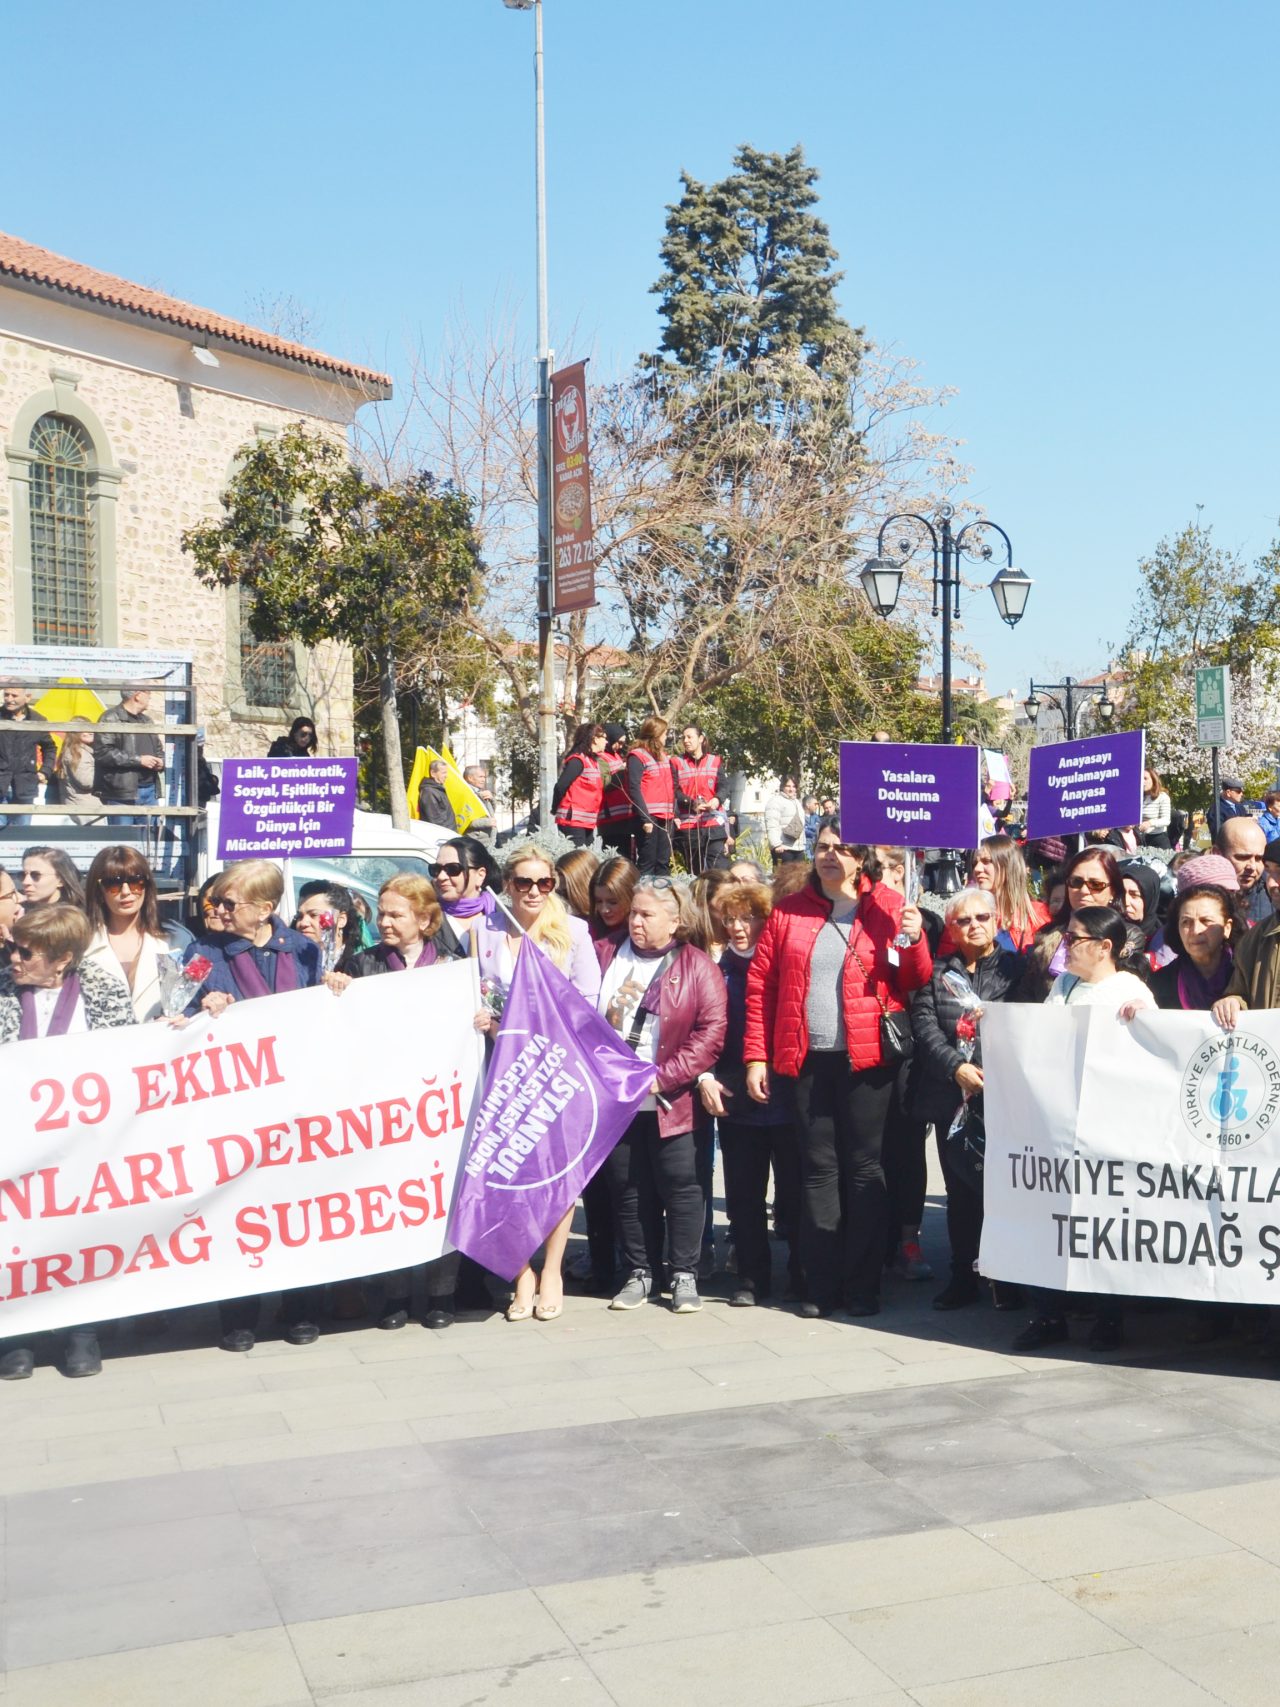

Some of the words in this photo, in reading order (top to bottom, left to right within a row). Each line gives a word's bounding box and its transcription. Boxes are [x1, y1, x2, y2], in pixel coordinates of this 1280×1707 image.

[559, 545, 571, 568] 263
[573, 542, 582, 564] 72
[583, 539, 593, 561] 72
[1058, 752, 1112, 769] Anayasayı
[237, 766, 268, 780] Laik,
[271, 765, 347, 779] Demokratik,
[881, 770, 936, 784] Yasalara
[1048, 768, 1119, 789] Uygulamayan
[233, 783, 279, 799] Sosyal,
[281, 782, 329, 799] Eşitlikçi
[331, 784, 345, 795] ve
[878, 788, 940, 802] Dokunma
[1061, 786, 1106, 802] Anayasa
[243, 800, 315, 817] Özgürlükçü
[317, 801, 335, 813] Bir
[886, 807, 932, 823] Uygula
[1059, 803, 1107, 819] Yapamaz
[256, 820, 297, 835] Dünya
[299, 817, 321, 834] İçin
[225, 837, 302, 854] Mücadeleye
[304, 837, 345, 849] Devam
[30, 1072, 111, 1132] 29
[132, 1033, 285, 1115] EKİM
[469, 1033, 550, 1150] VAZGEÇMİYO
[1185, 1063, 1204, 1129] TÜRKİYE
[1200, 1036, 1268, 1064] SAKATLAR
[1255, 1060, 1280, 1131] DERNEĞİ
[465, 1043, 568, 1178] SÖZLEŞMESİ'NDEN
[207, 1070, 465, 1186] DERNEĞİ
[486, 1069, 585, 1180] İSTANBUL
[1217, 1134, 1242, 1145] 1960
[1008, 1146, 1124, 1197] TÜRKİYE
[0, 1208, 212, 1301] İRDAĞ
[235, 1160, 446, 1268] ŞUBESİ
[1052, 1207, 1243, 1268] TEKİRDAĞ
